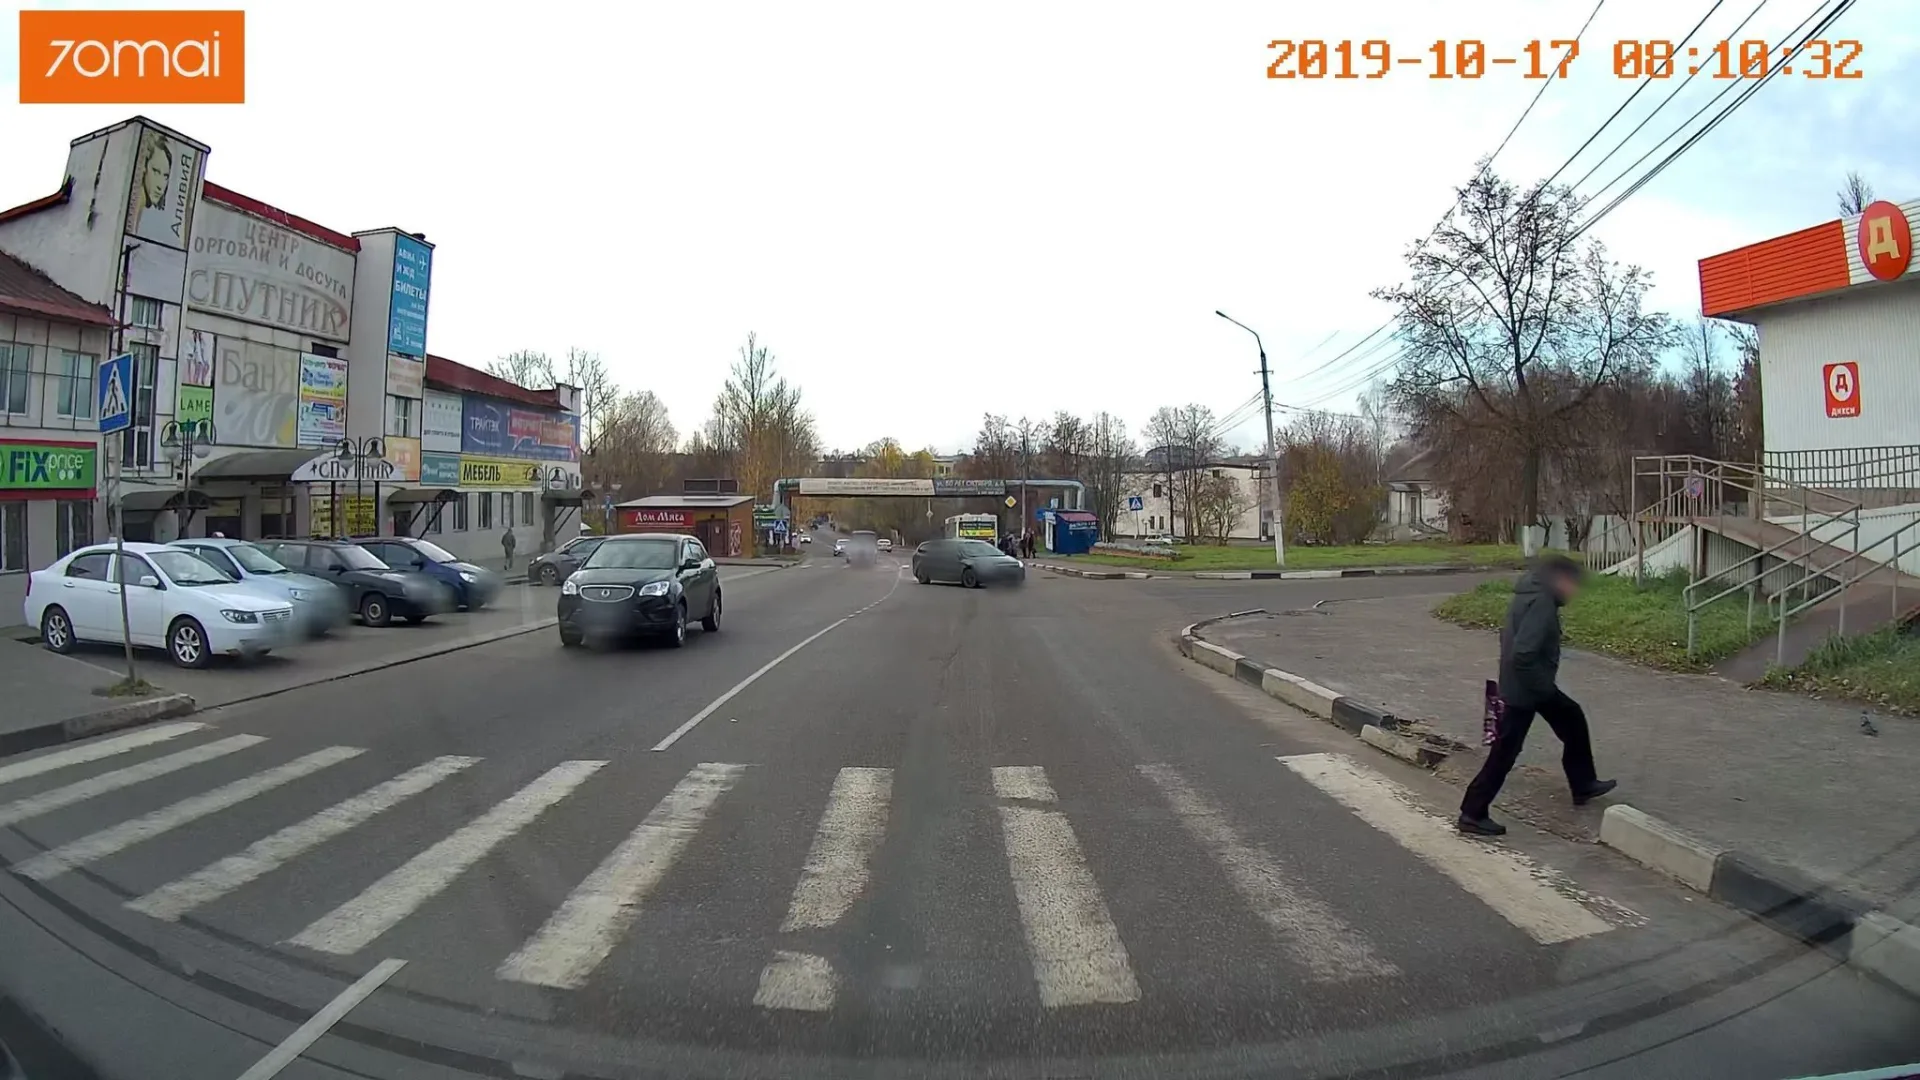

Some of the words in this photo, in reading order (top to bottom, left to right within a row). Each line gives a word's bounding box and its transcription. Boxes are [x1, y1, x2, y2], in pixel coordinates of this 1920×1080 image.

[245, 221, 299, 255] ЦЕНТР
[1867, 215, 1901, 264] Д
[194, 236, 271, 264] ОРГОВЛИ
[279, 253, 289, 271] И
[295, 261, 347, 299] ДОСУГА
[189, 269, 343, 336] СПУТНИК
[395, 280, 427, 300] БИЛЕТЫ
[1835, 373, 1849, 393] Д
[1831, 407, 1856, 417] ДИКСИ
[463, 464, 501, 481] МЕБЕЛЬ
